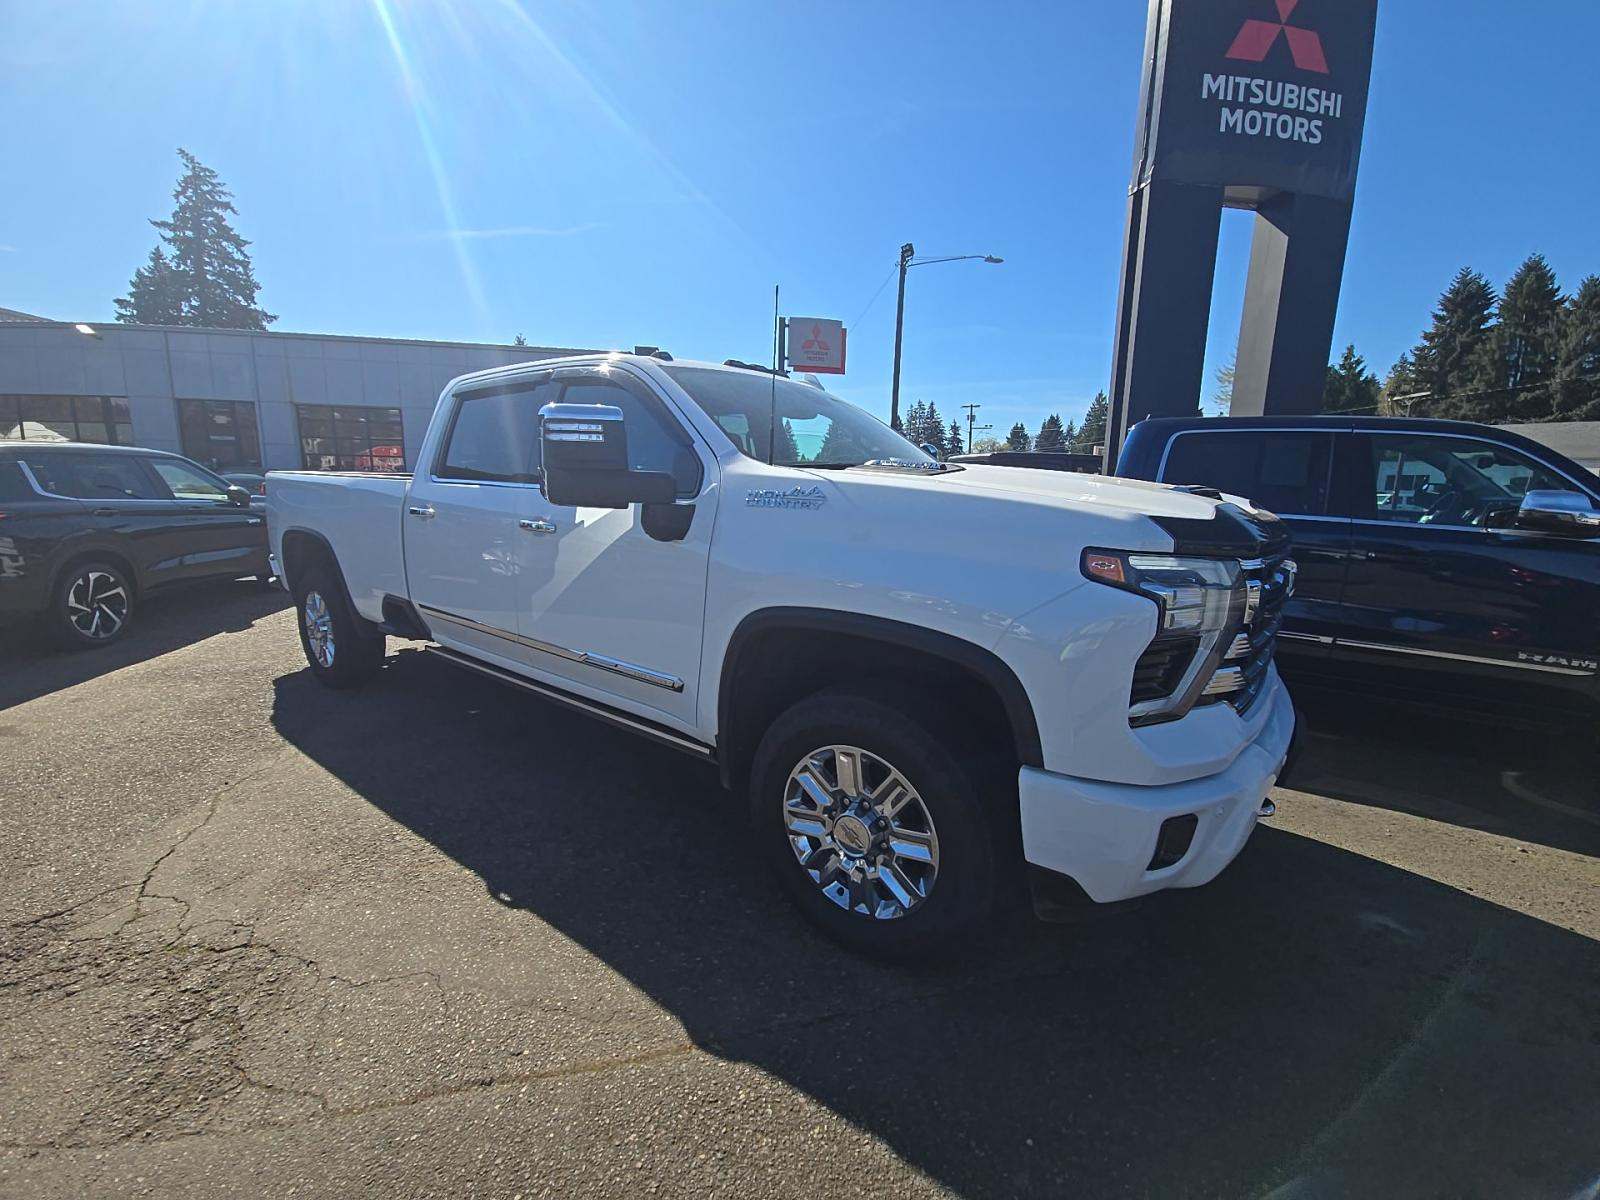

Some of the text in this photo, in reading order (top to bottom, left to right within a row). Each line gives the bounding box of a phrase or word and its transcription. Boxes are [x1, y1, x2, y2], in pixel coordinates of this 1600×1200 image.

[1201, 73, 1342, 118] MITSUBISHI
[1219, 107, 1323, 144] MOTORS
[745, 498, 824, 512] COUNTRY
